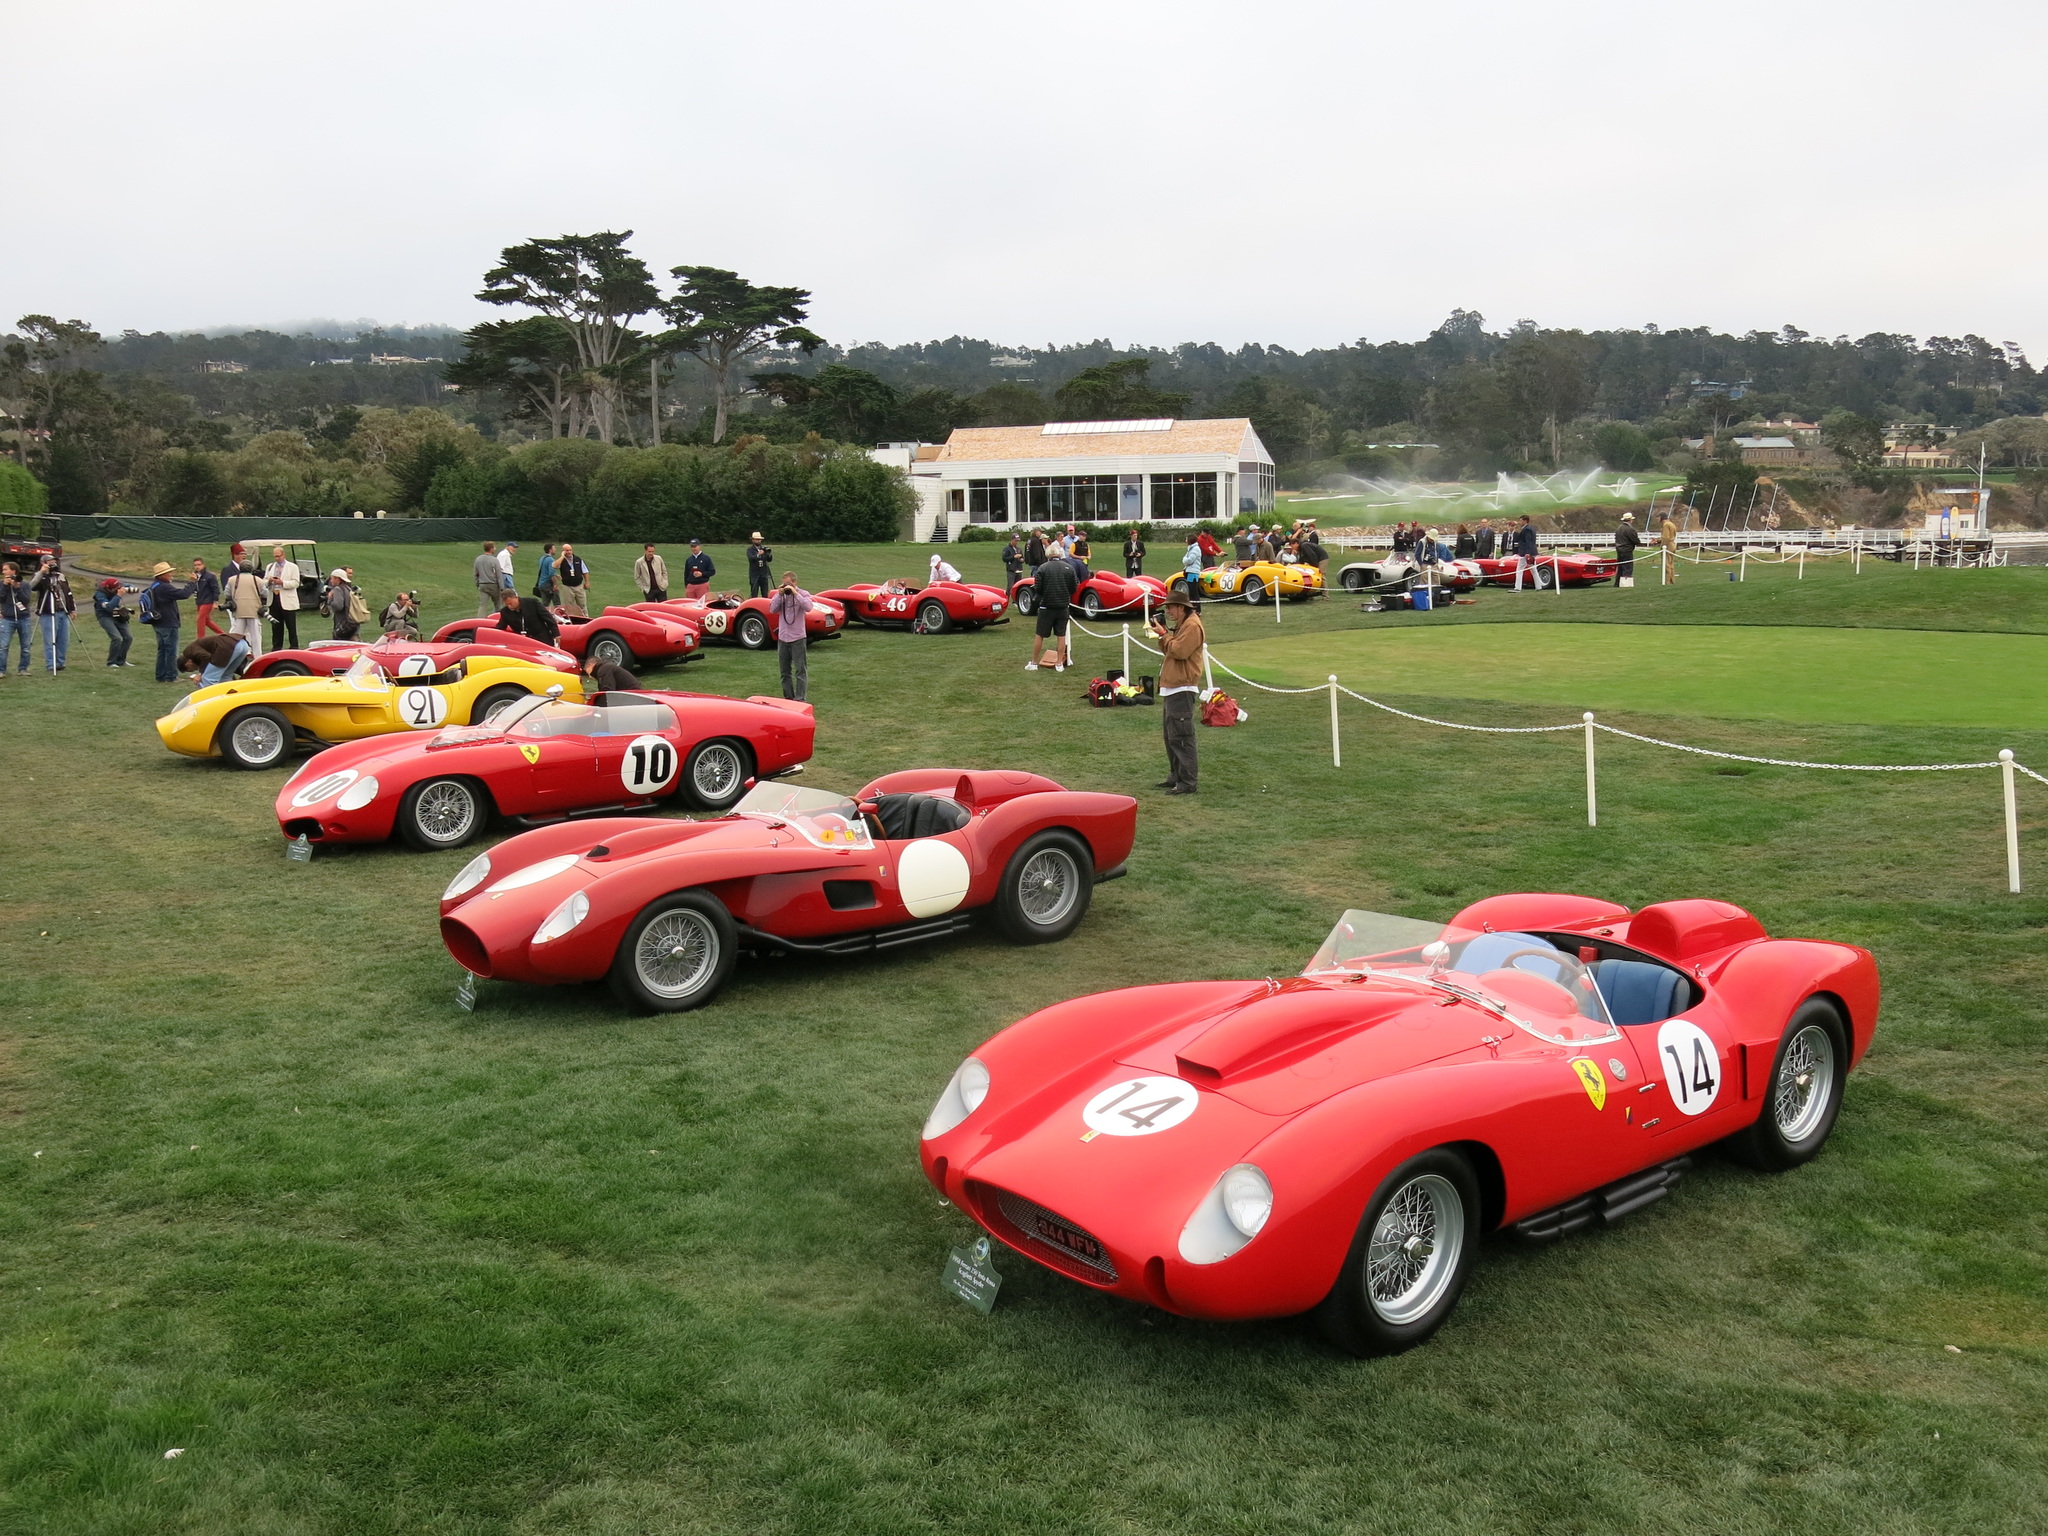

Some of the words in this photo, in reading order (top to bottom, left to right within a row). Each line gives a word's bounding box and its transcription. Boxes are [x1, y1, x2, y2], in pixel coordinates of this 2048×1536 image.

[1221, 574, 1235, 590] 58
[887, 597, 908, 612] 46
[706, 614, 724, 627] 38
[410, 658, 428, 675] 7
[407, 689, 436, 725] 21
[631, 743, 671, 785] 10
[299, 774, 351, 802] 10
[1664, 1037, 1715, 1104] 14
[1095, 1081, 1185, 1129] 14
